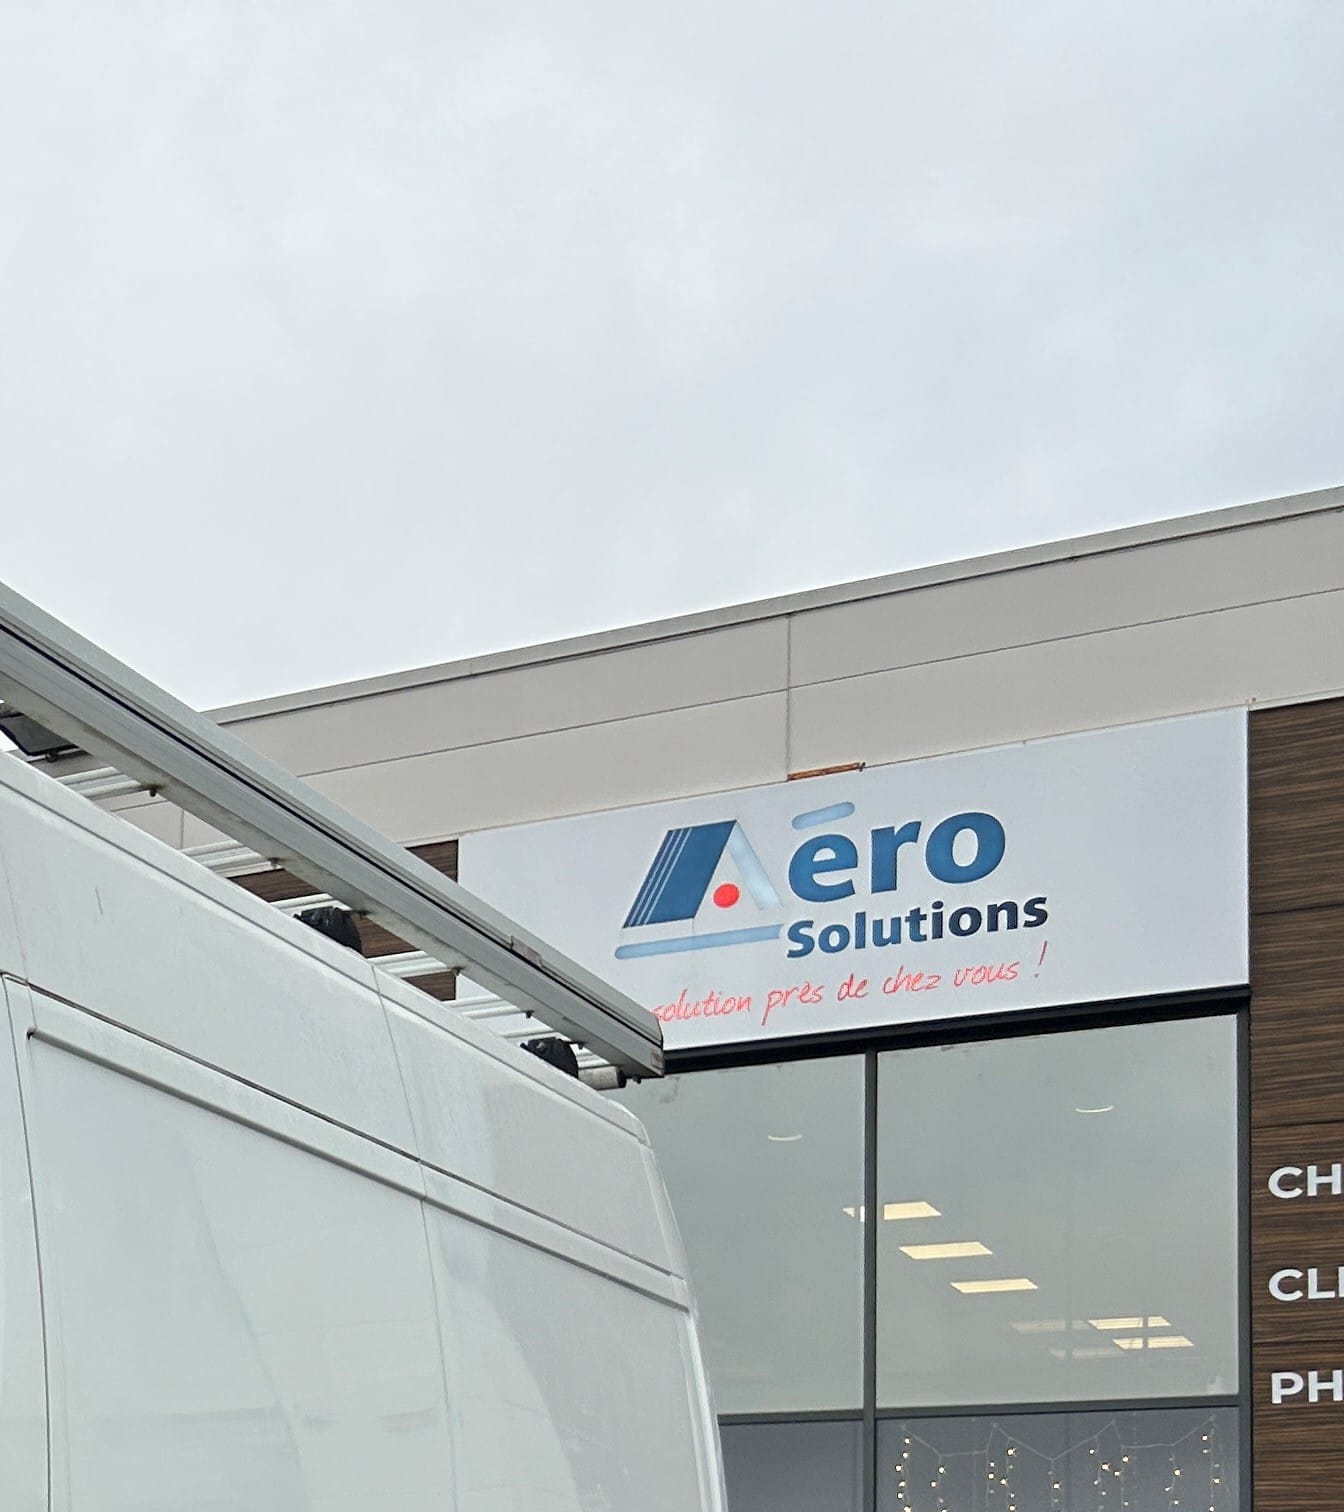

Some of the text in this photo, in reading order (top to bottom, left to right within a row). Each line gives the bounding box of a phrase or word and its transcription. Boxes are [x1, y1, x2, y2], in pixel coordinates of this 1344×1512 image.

[786, 897, 1049, 959] Solutions
[652, 988, 751, 1023] solution
[761, 984, 823, 1025] près
[837, 973, 869, 1001] de
[882, 965, 942, 994] chez
[953, 960, 1020, 987] vous
[1268, 1163, 1343, 1199] CH
[1271, 1369, 1344, 1404] PH
